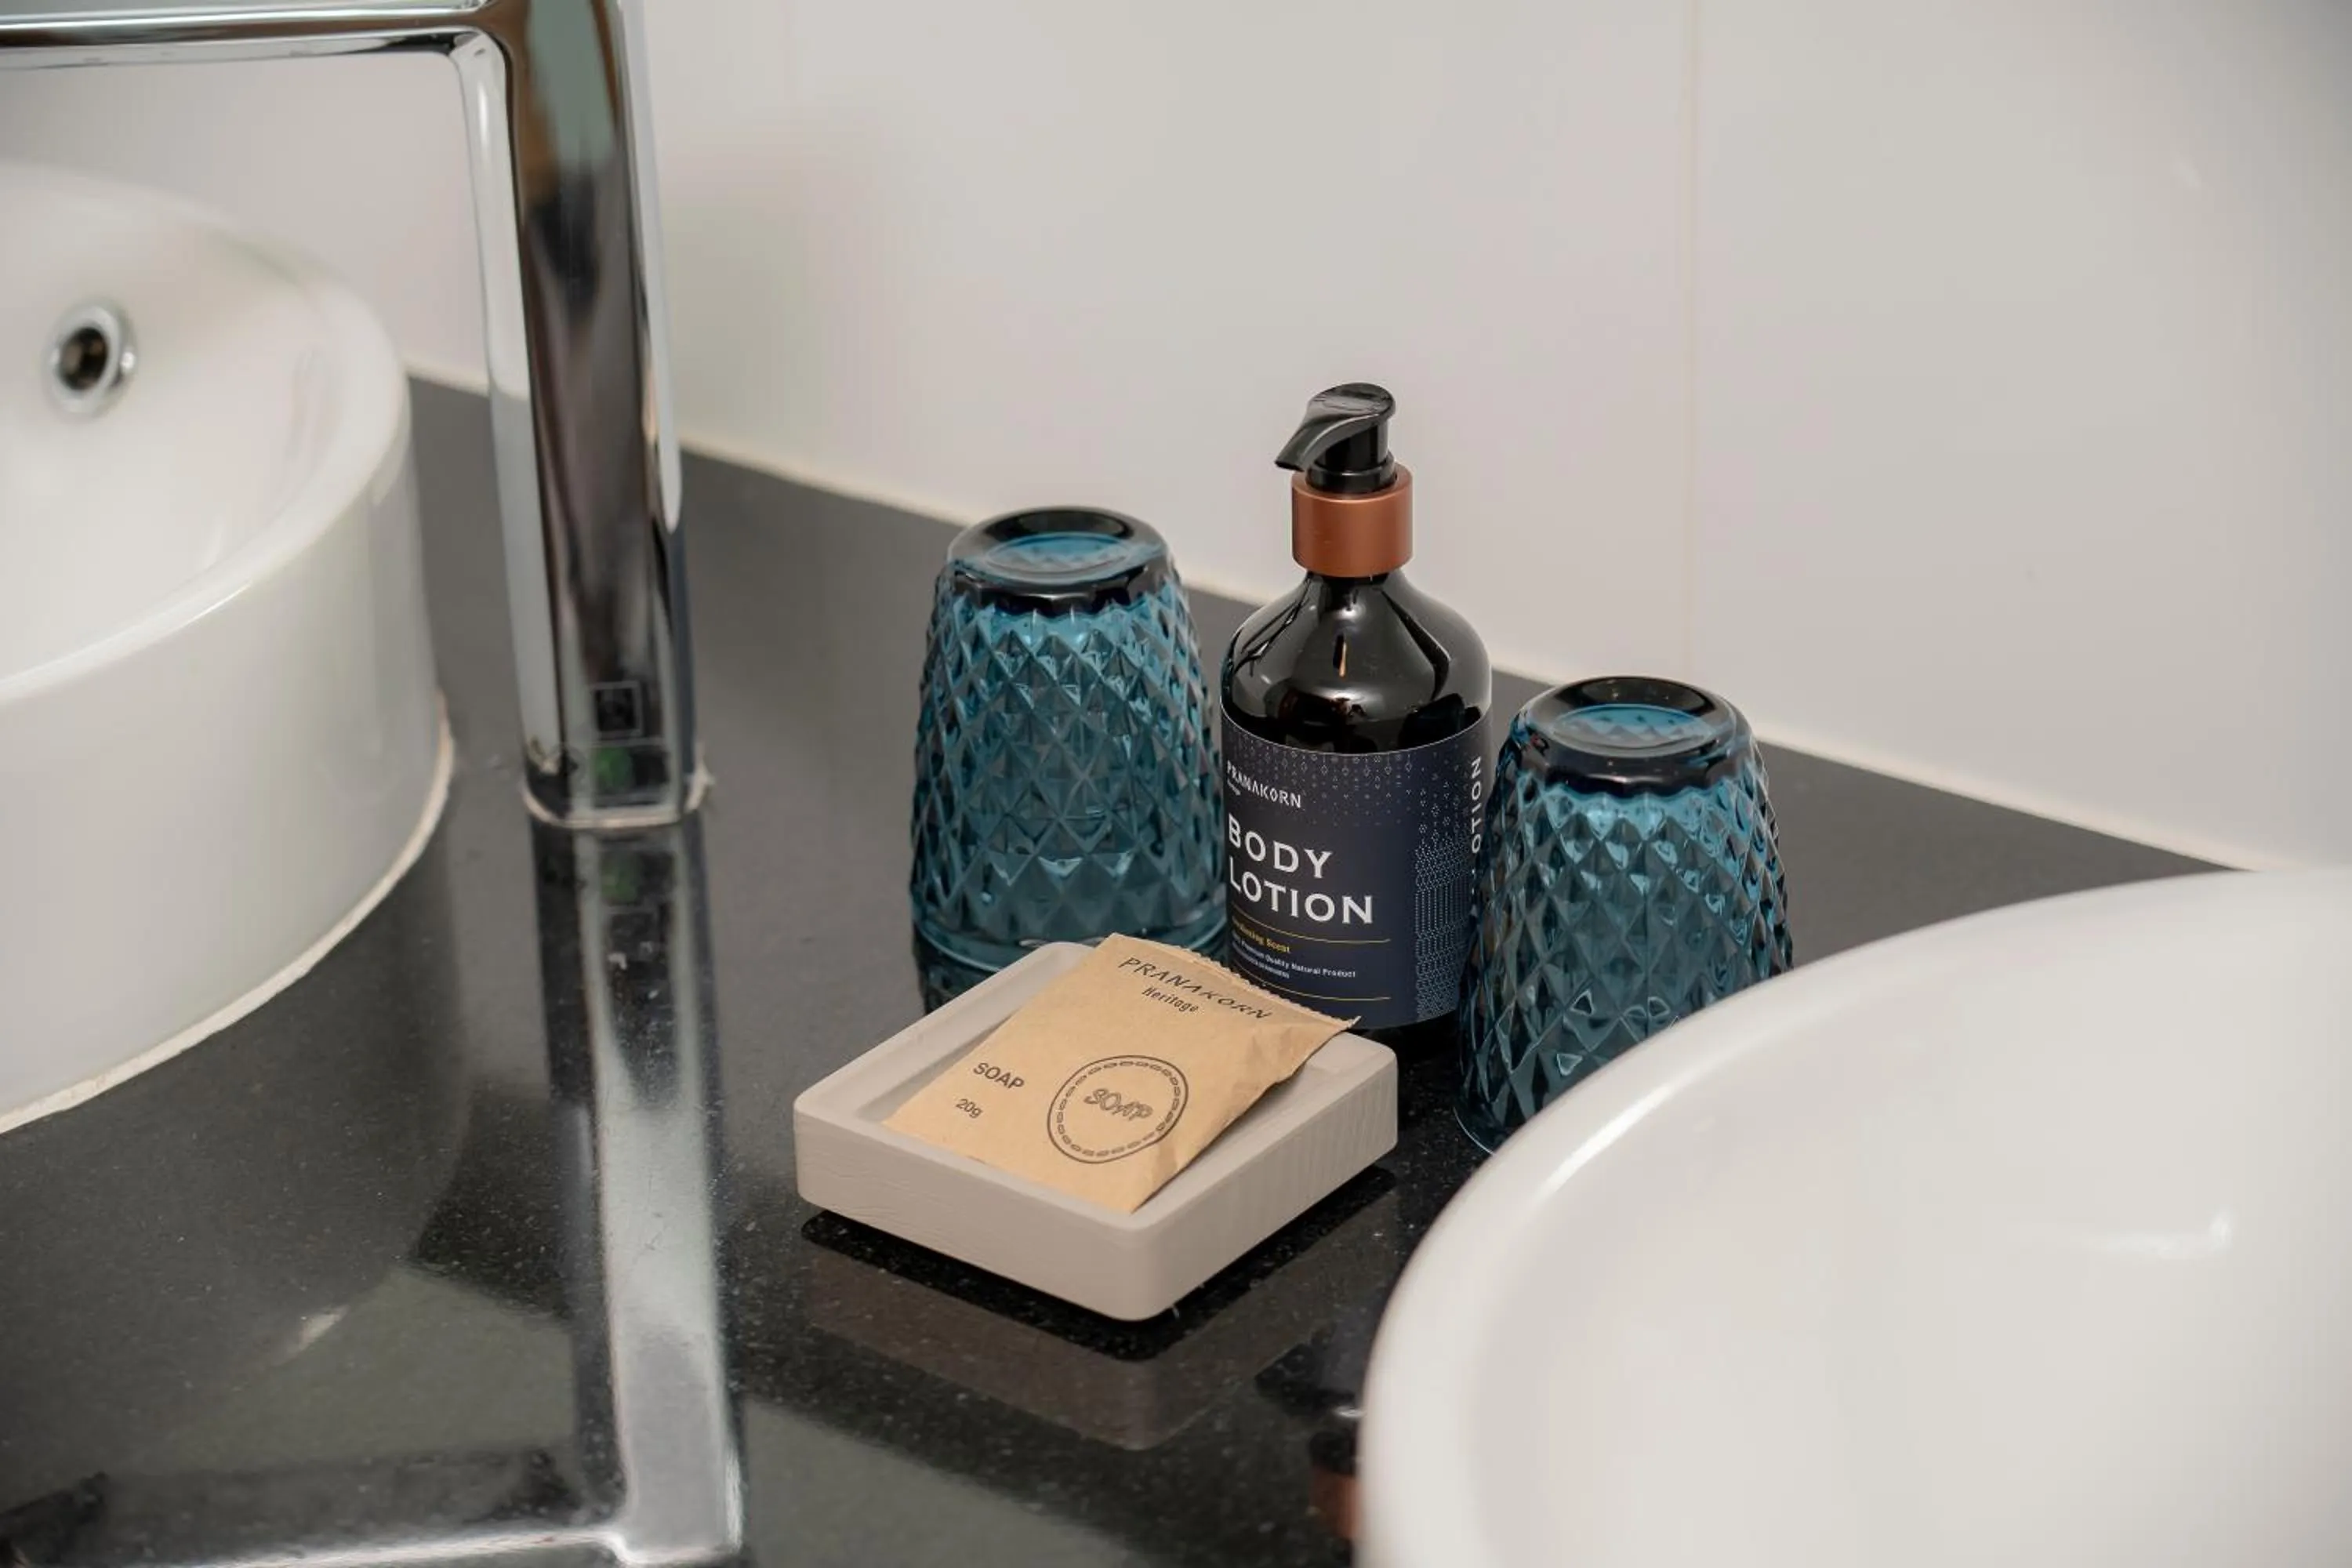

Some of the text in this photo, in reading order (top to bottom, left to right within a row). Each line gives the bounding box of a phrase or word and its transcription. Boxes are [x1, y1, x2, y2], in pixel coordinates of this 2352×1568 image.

[1226, 759, 1301, 808] PRANAKORN
[1471, 756, 1482, 874] OTION
[1229, 813, 1332, 879] BODY
[1229, 855, 1373, 924] LOTION
[1265, 954, 1290, 970] Quality
[1291, 963, 1321, 975] Natural
[1323, 968, 1356, 978] Product
[1118, 956, 1273, 1019] PRANAKORN
[1142, 985, 1200, 1012] Heritage
[973, 1062, 1025, 1089] SOAP
[956, 1098, 983, 1119] 20g
[1083, 1088, 1153, 1122] SOAP
